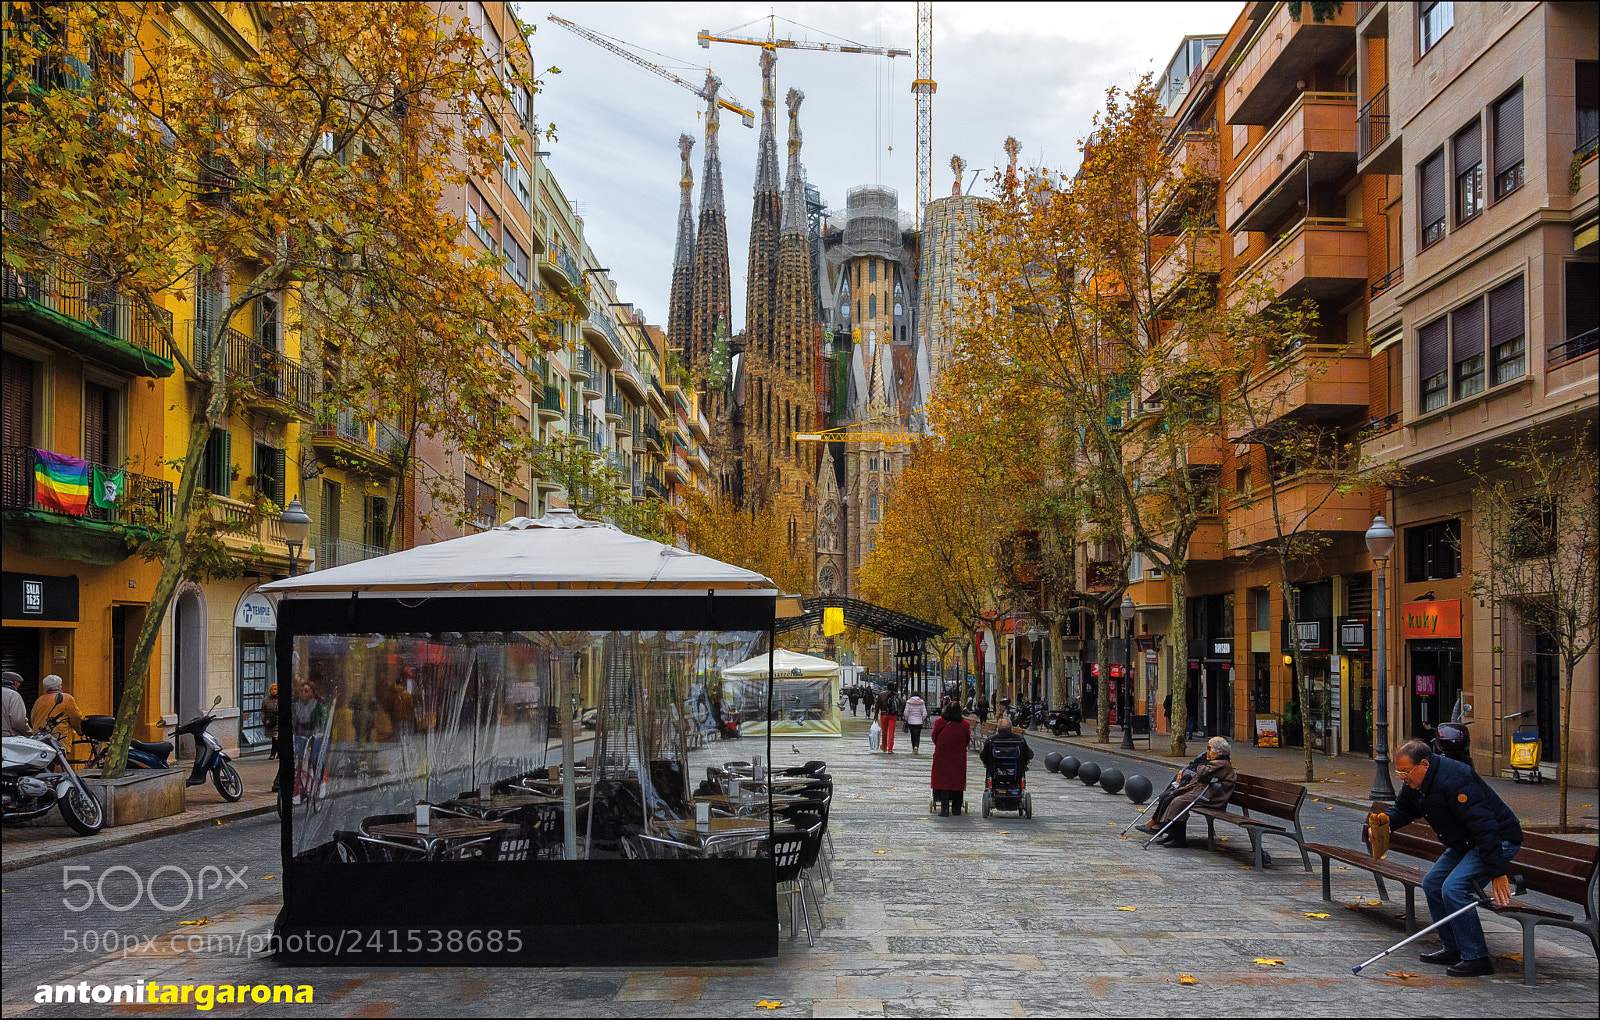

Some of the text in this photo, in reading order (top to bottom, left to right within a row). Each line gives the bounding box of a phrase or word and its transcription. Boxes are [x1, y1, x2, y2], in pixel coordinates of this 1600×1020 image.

[26, 583, 40, 595] SALA
[26, 594, 40, 606] 1625
[252, 605, 270, 616] TEMPLE
[1408, 611, 1438, 633] kuky
[500, 840, 530, 852] COPA
[774, 841, 803, 854] COPA
